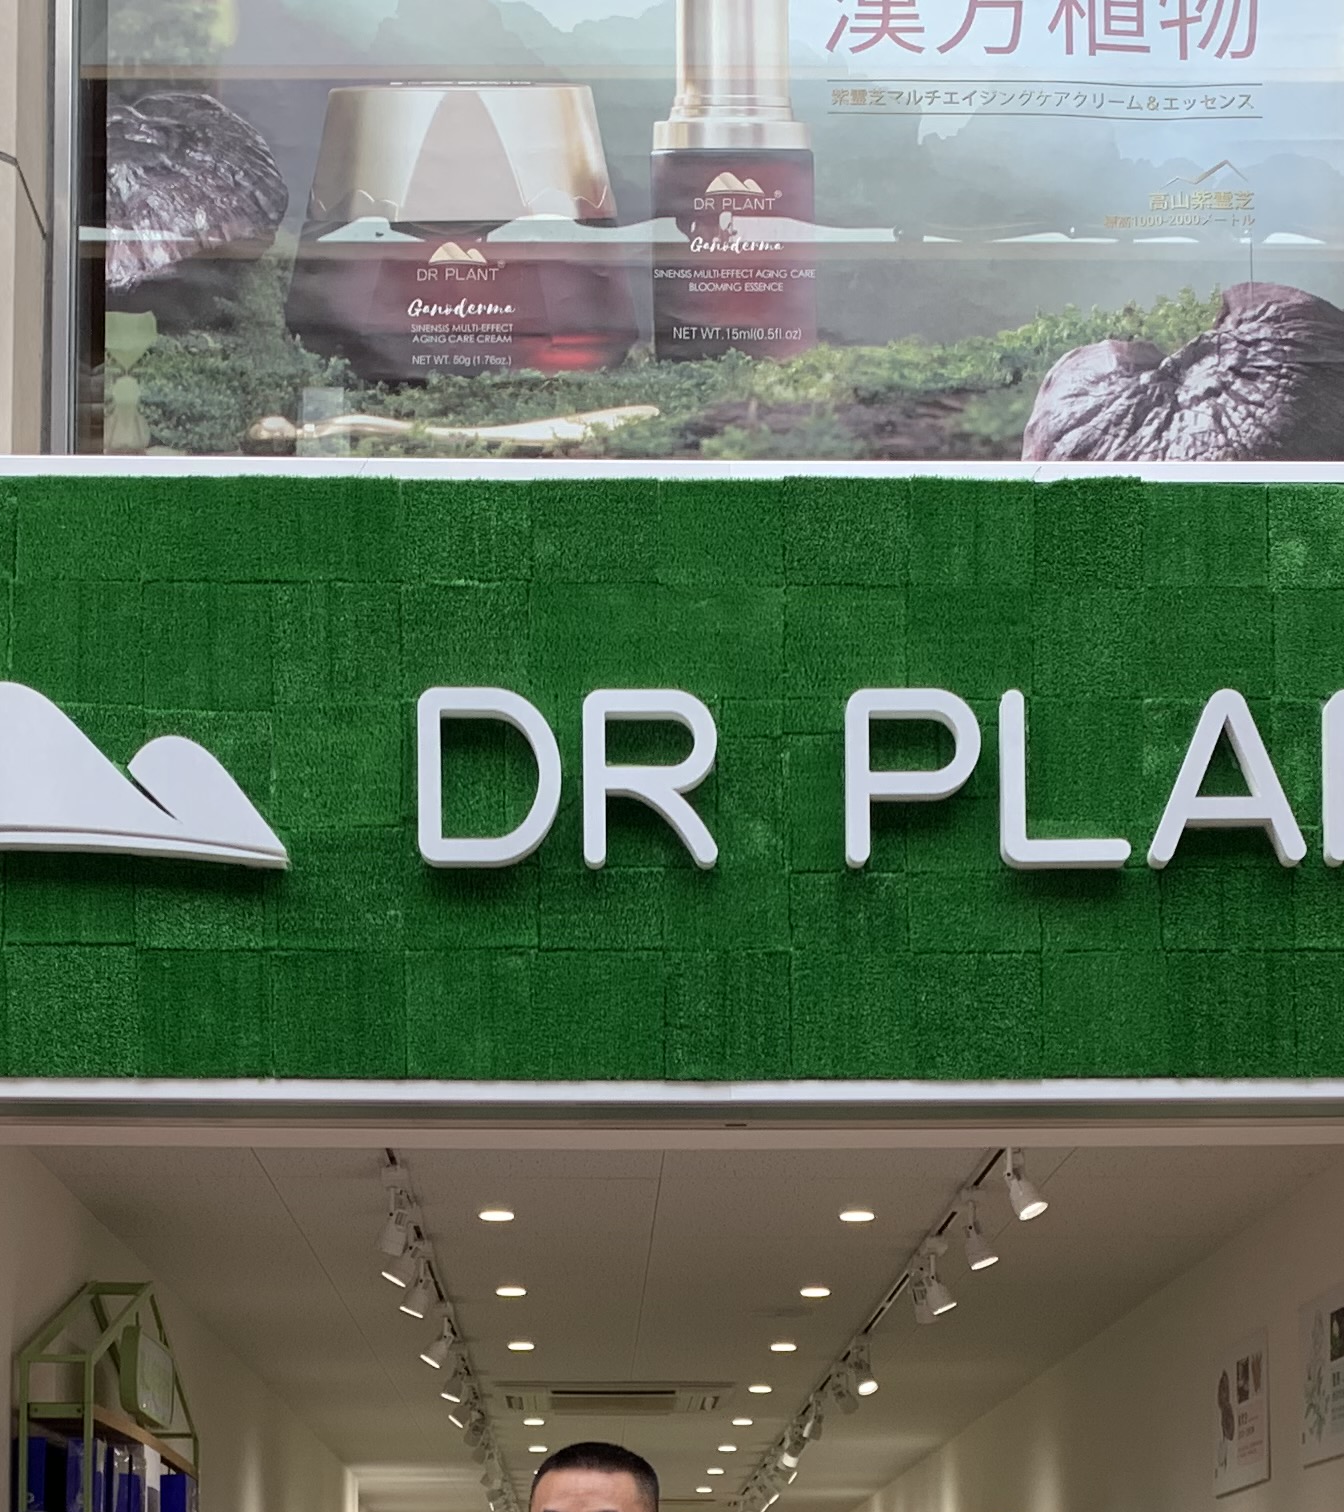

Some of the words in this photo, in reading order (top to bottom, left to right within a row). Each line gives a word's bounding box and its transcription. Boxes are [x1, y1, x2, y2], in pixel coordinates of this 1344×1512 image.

[693, 197, 715, 211] DR
[721, 197, 776, 211] PLANT
[690, 236, 785, 254] Ganoderma
[416, 268, 439, 282] DR
[444, 267, 500, 281] PLANT
[756, 268, 788, 280] AGING
[790, 268, 817, 280] CARE
[688, 281, 742, 292] BLOOMING
[744, 281, 785, 292] ESSENCE
[407, 298, 516, 318] Ganoderma
[410, 323, 450, 334] SINENSIS
[451, 323, 514, 334] MULTI-EFFECT
[672, 326, 698, 341] NET
[412, 334, 447, 344] AGING
[448, 334, 475, 344] CARE
[476, 334, 513, 344] CREAM
[411, 354, 431, 366] NET
[417, 685, 719, 871] DR
